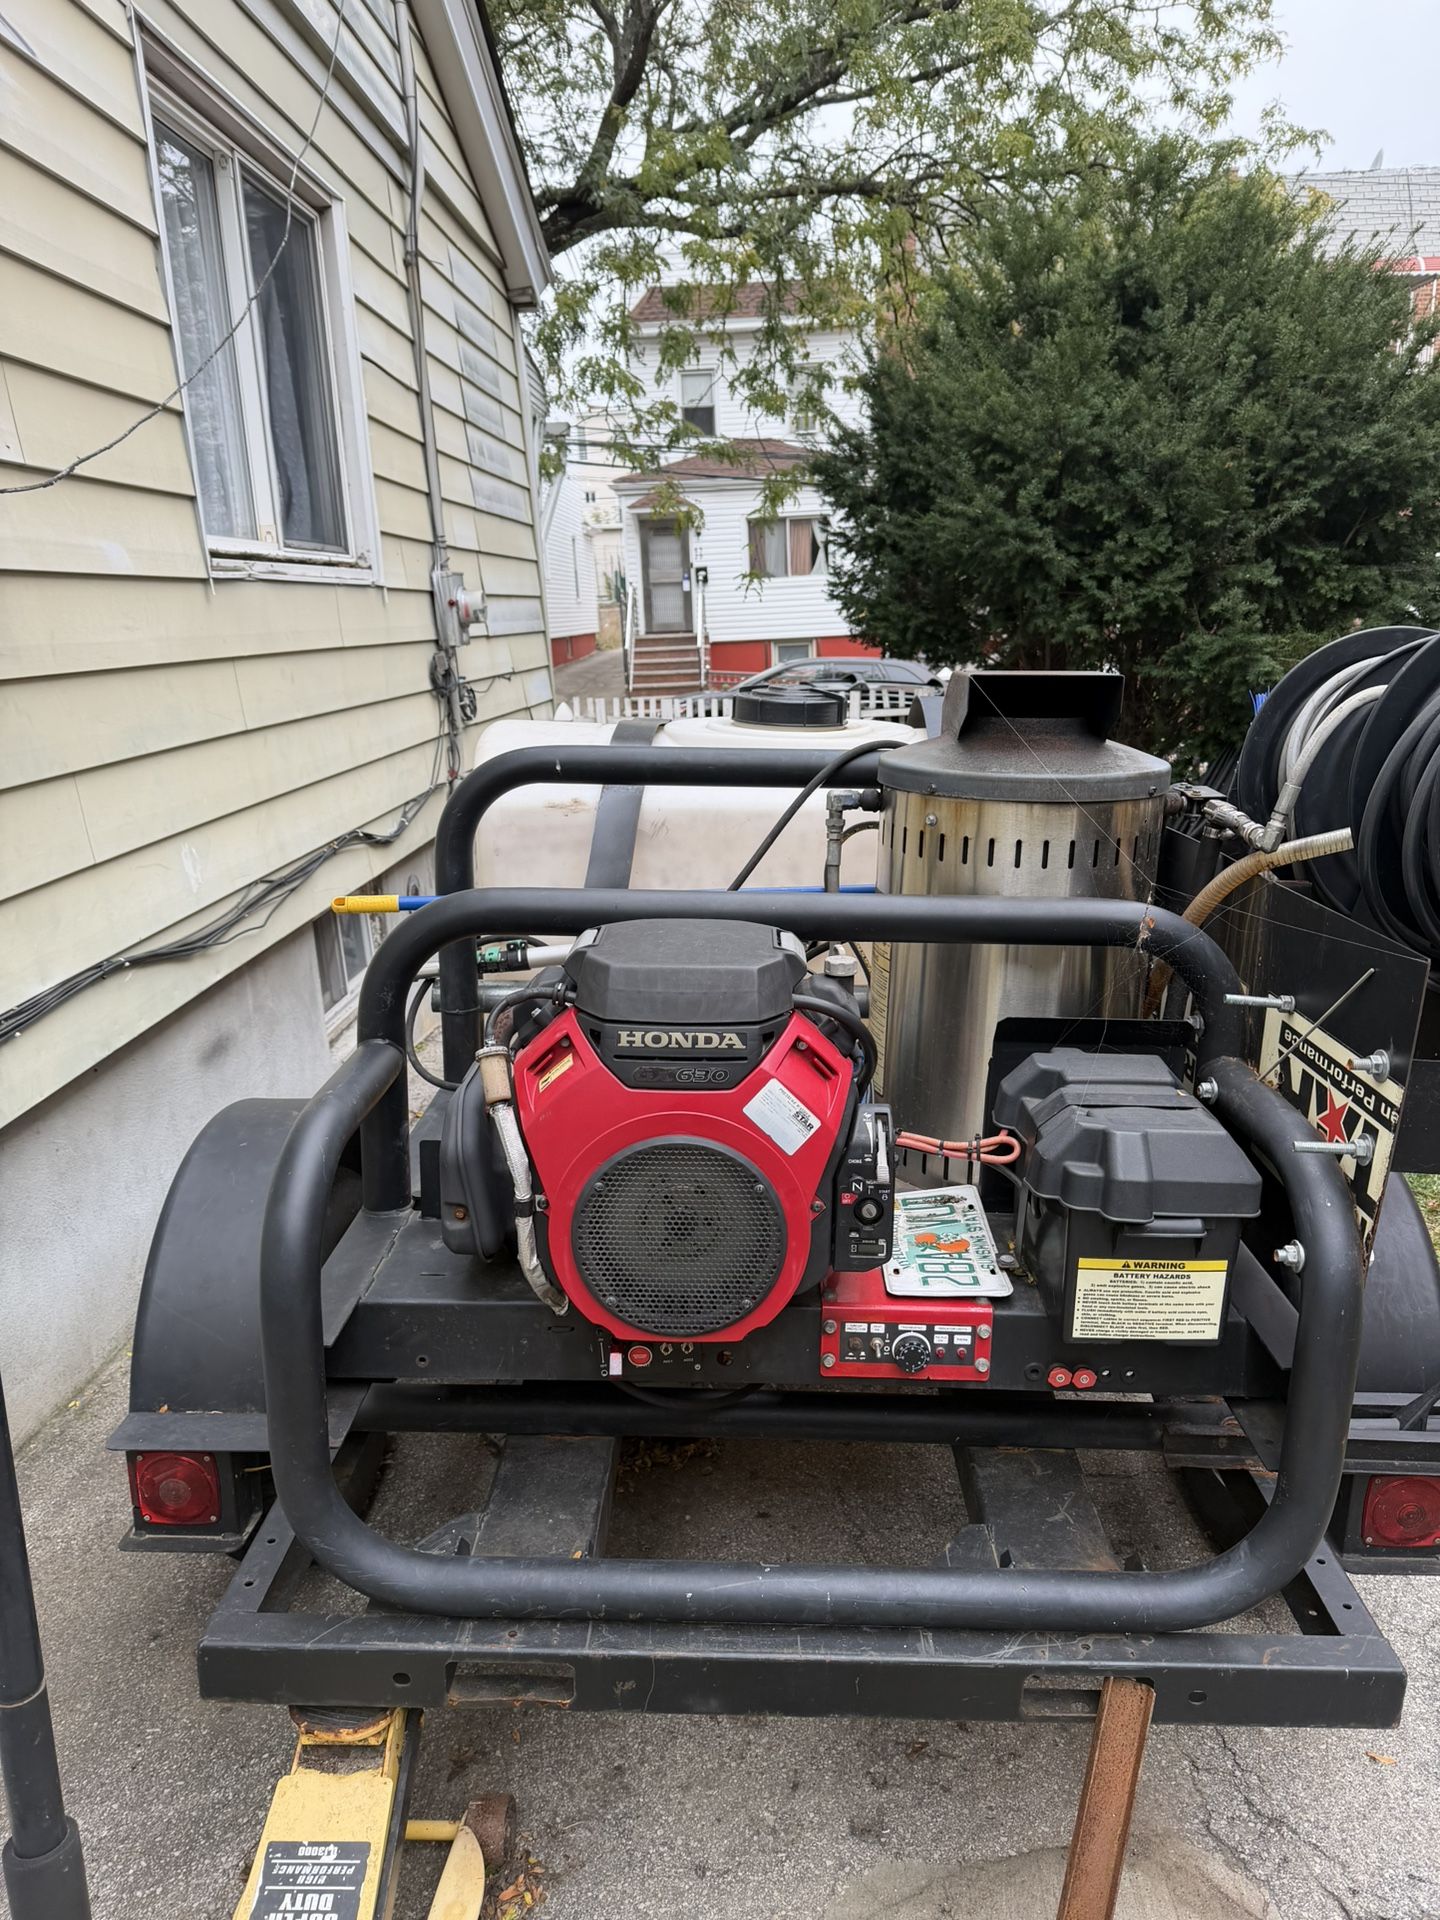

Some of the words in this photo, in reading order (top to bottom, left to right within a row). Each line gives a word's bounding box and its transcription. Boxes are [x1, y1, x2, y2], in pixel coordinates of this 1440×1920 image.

[618, 1031, 746, 1048] HONDA
[1284, 1028, 1375, 1112] Performance
[794, 1110, 814, 1132] STAR
[962, 1206, 984, 1233] STATE
[970, 1235, 996, 1270] SUNSHINE
[272, 1865, 355, 1875] PERFORMANCE
[296, 1875, 326, 1884] HIGH
[279, 1893, 334, 1910] DUTY
